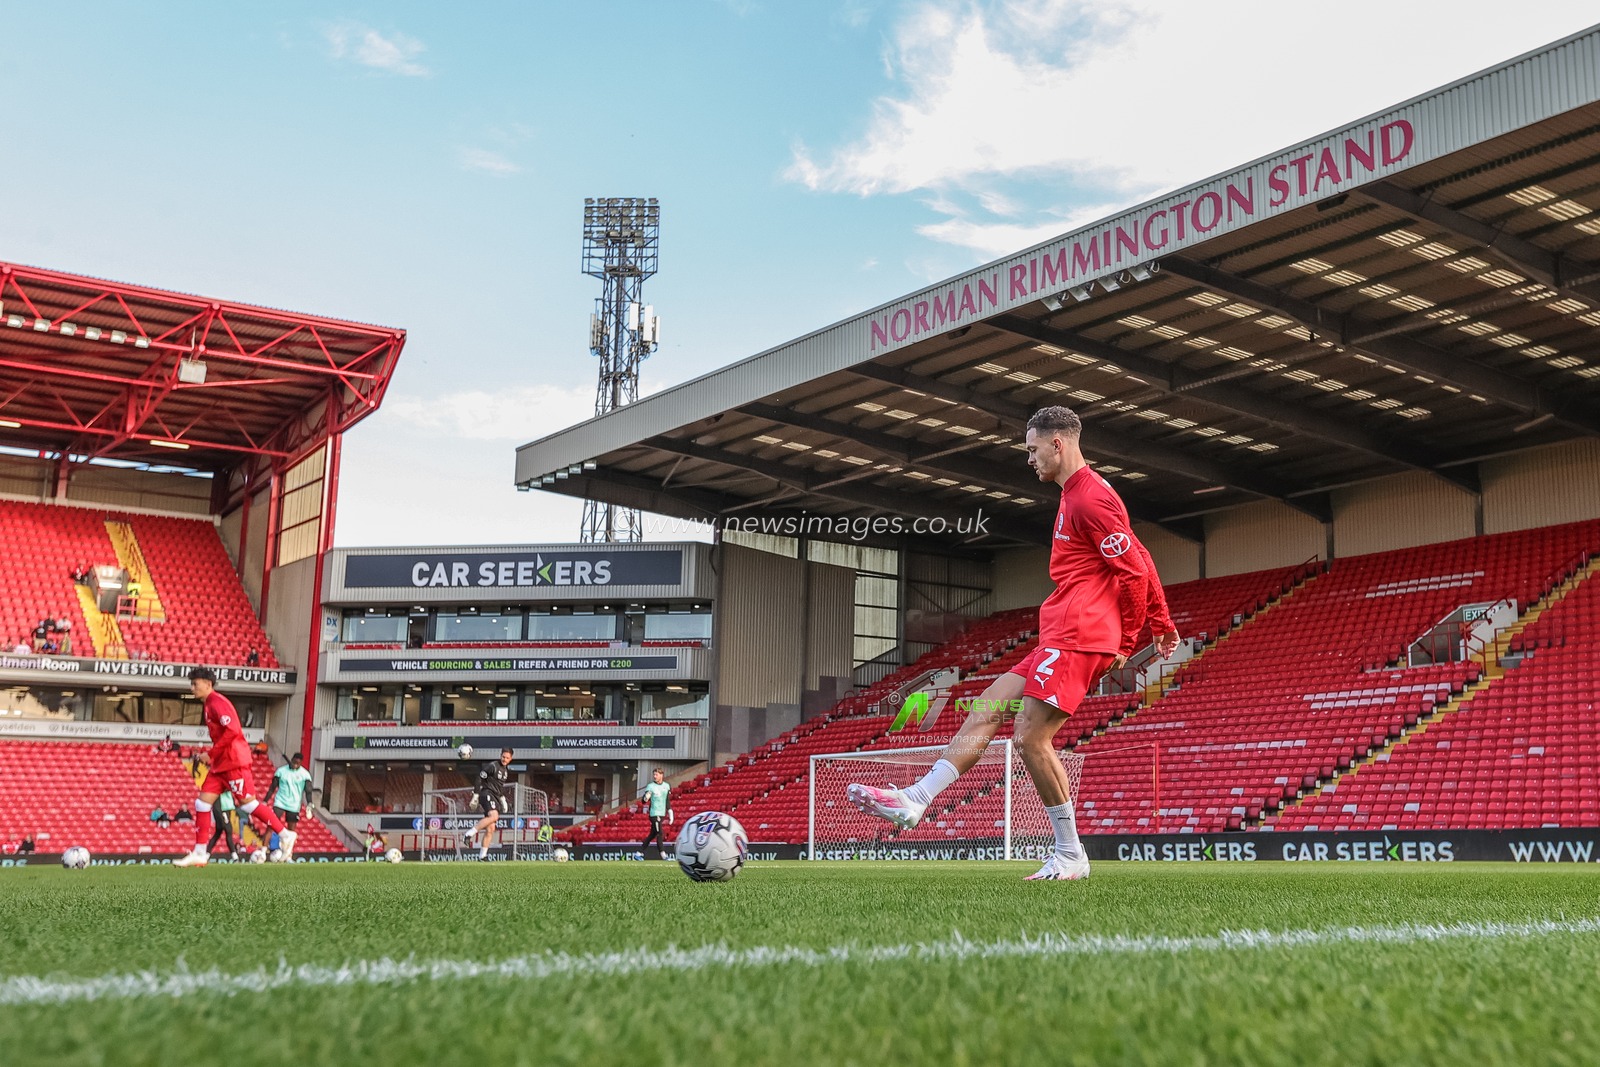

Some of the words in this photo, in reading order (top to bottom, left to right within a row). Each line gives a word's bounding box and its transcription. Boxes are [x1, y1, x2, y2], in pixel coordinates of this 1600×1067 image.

[870, 273, 998, 350] NORMAN
[1009, 176, 1254, 300] RIMMINGTON
[1268, 119, 1414, 207] STAND
[411, 561, 470, 587] CAR
[477, 553, 612, 587] SEEKERS
[326, 616, 337, 627] DX
[391, 660, 428, 670] VEHICLE
[429, 660, 473, 670] SOURCING
[475, 660, 482, 669] &
[483, 660, 511, 669] SALES
[518, 660, 548, 669] REFER
[549, 659, 555, 669] A
[556, 659, 589, 669] FRIEND
[591, 659, 609, 669] FOR
[610, 659, 632, 668] £200
[1036, 648, 1061, 676] 2
[94, 661, 174, 677] INVESTING
[234, 670, 287, 683] FUTURE
[369, 738, 449, 748] WWW.CARSEEKERS.UK
[556, 738, 638, 747] WWW.CARSEEKERS.UK
[229, 779, 244, 795] 37
[444, 820, 508, 829] @CARSERS1
[1117, 843, 1156, 862] CAR
[1161, 836, 1257, 862] SEEKERS
[1282, 842, 1329, 862] CAR
[1336, 835, 1455, 862] SEEKERS
